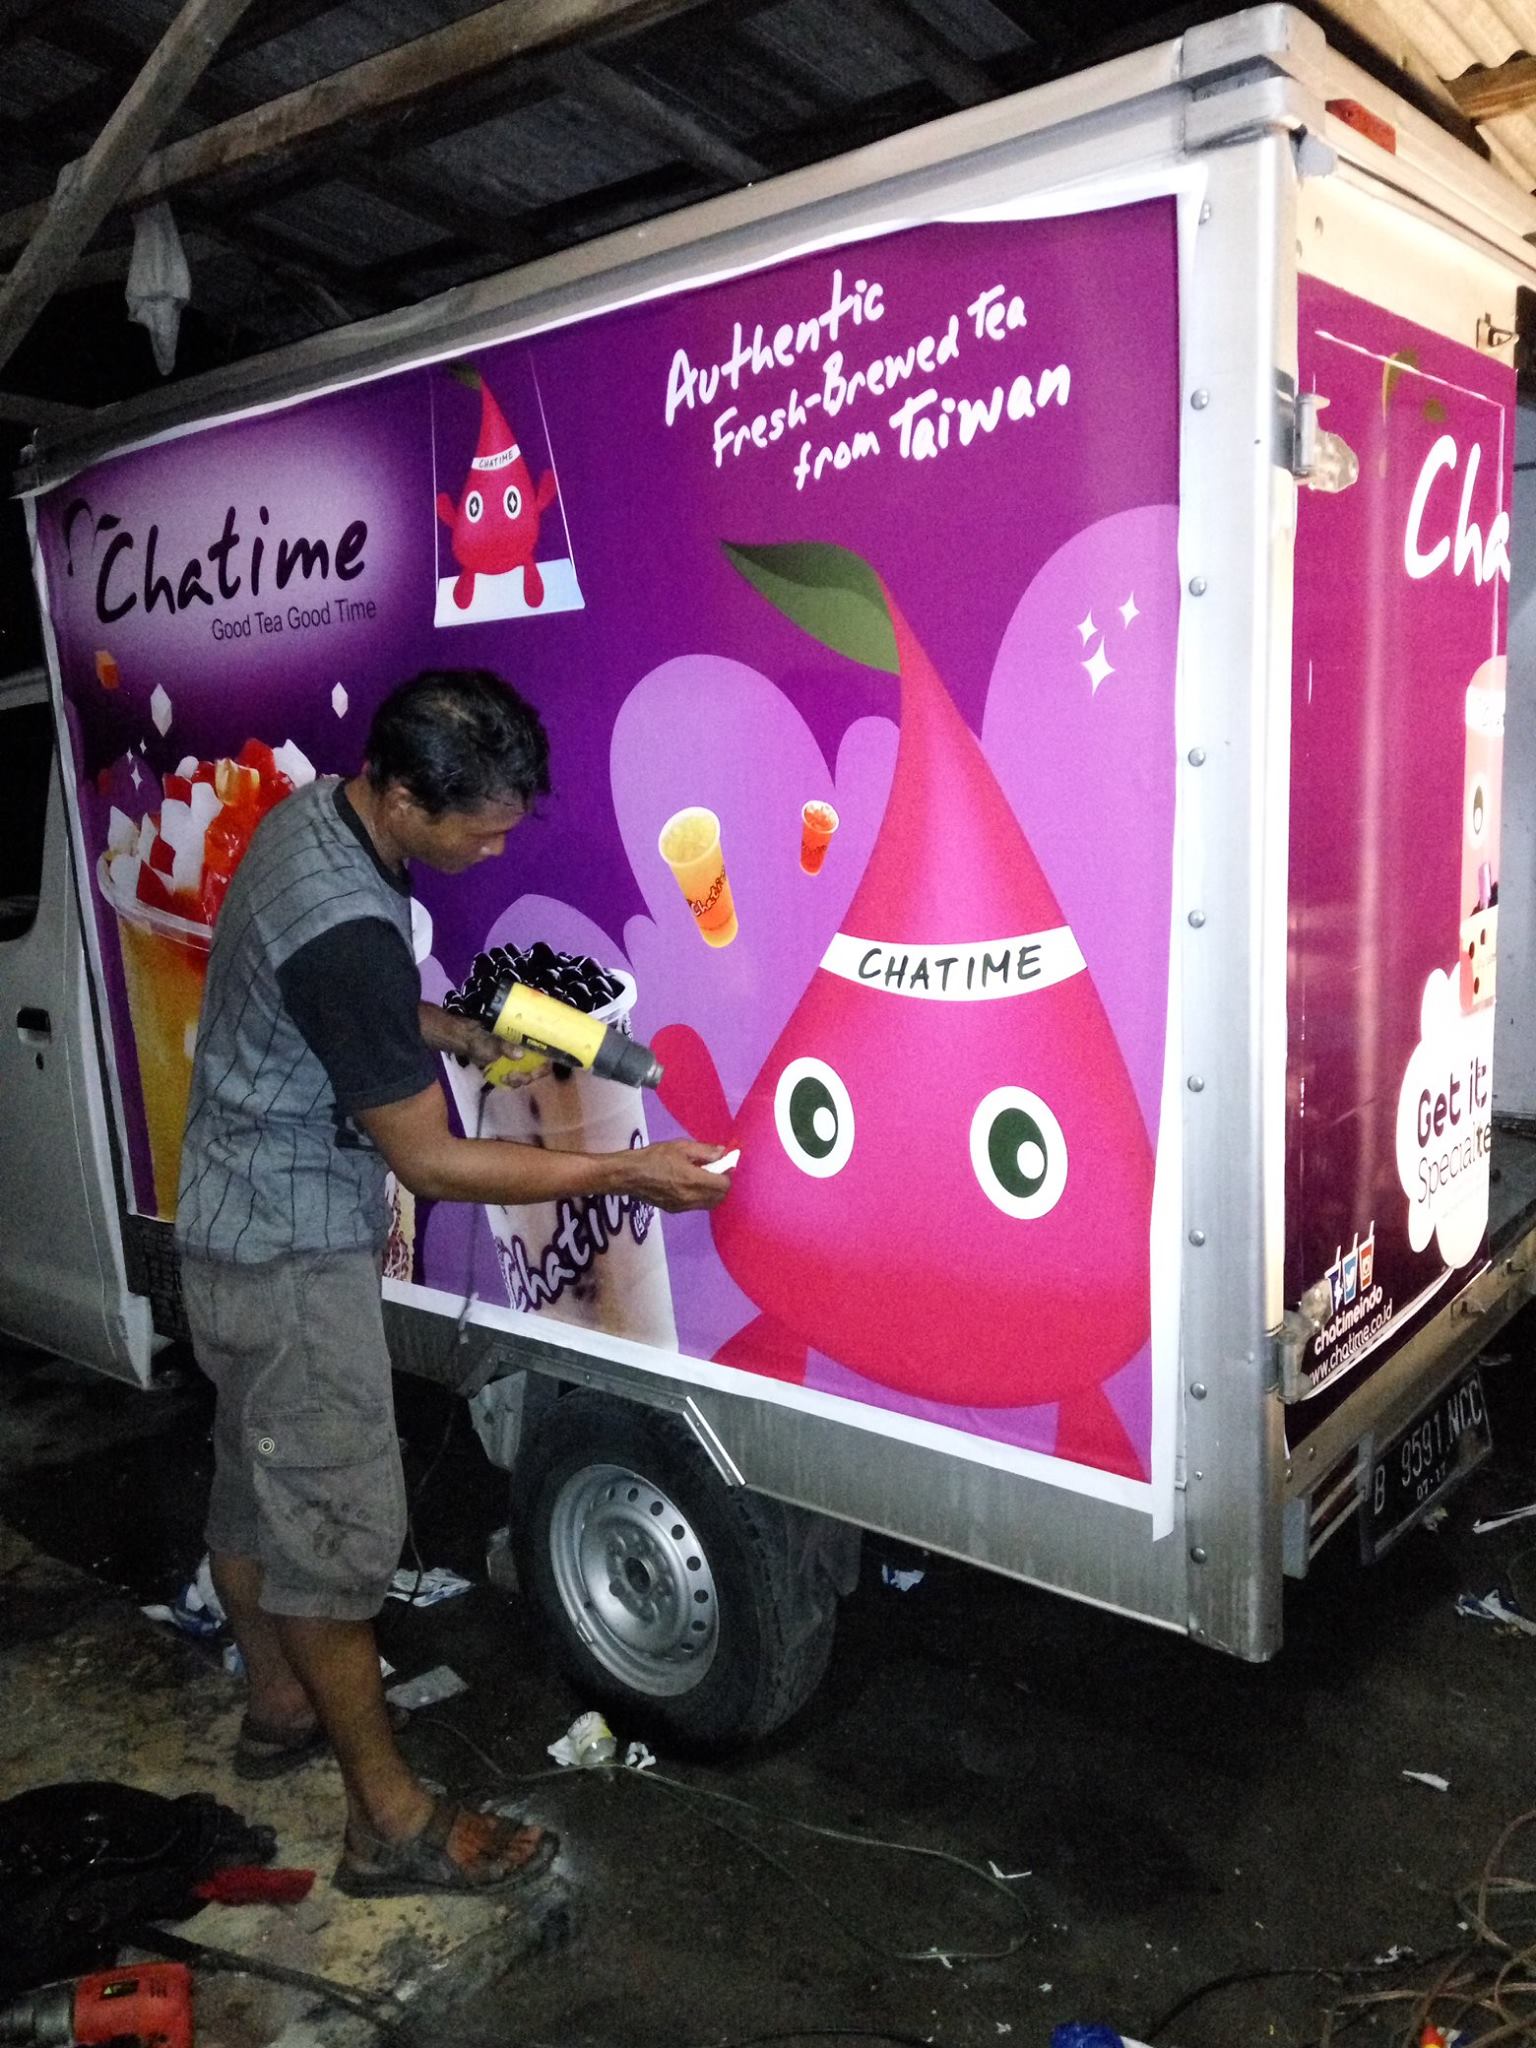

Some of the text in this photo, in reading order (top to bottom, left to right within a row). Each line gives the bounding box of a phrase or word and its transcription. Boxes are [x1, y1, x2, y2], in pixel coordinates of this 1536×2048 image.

[664, 268, 885, 427] Authentic
[713, 283, 1028, 468] Fresh-Brewed Tea
[478, 449, 514, 469] CHATIME
[793, 364, 1071, 491] from Taiwan
[95, 505, 368, 624] Chatime
[212, 598, 377, 641] Good Tea Good Time
[858, 944, 1042, 992] CHATIME
[1417, 1056, 1488, 1149] Get it
[1313, 1285, 1384, 1356] chatimeindo
[1374, 1379, 1483, 1516] B 9591 NCC
